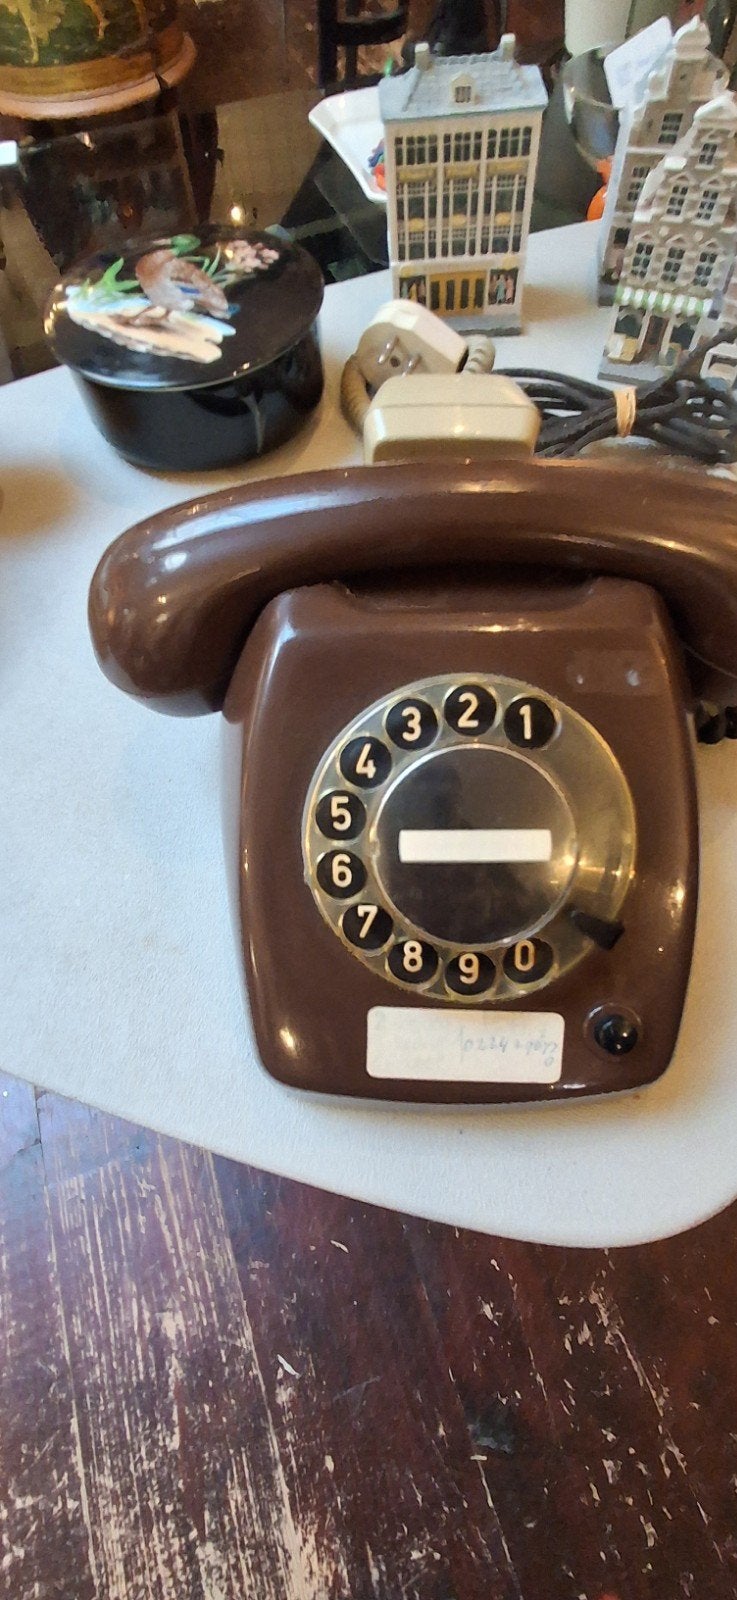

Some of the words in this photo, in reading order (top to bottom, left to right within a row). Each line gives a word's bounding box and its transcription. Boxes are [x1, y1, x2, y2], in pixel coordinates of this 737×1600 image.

[401, 706, 422, 742] 3
[457, 693, 479, 728] 2
[519, 705, 532, 740] 1
[355, 743, 377, 779] 4
[330, 796, 352, 831] 5
[331, 854, 353, 888] 6
[357, 904, 378, 939] 7
[403, 940, 423, 973] 8
[458, 953, 479, 985] 9
[513, 938, 535, 972] 0
